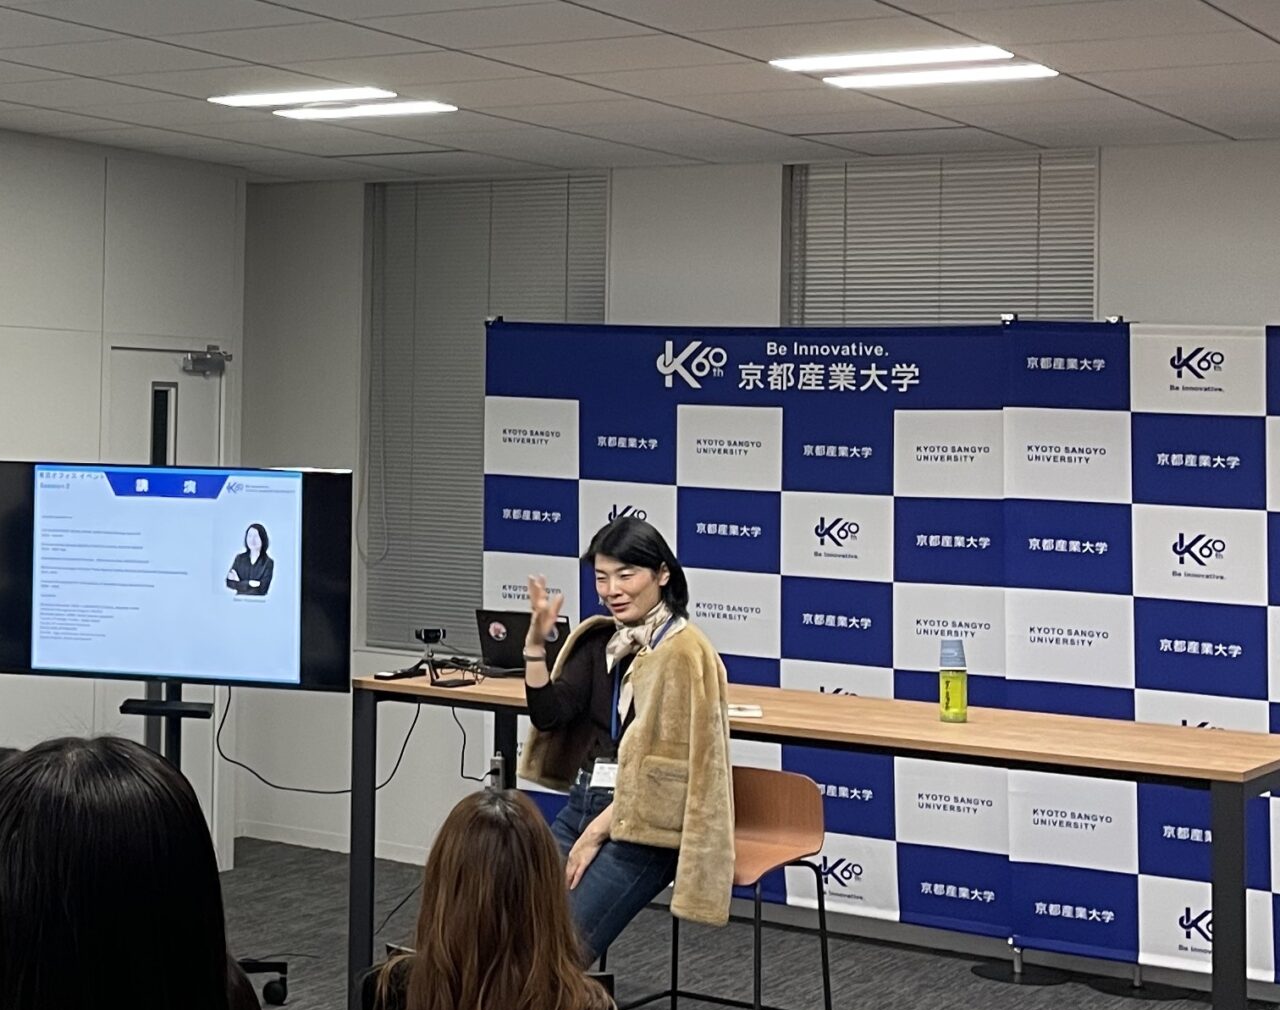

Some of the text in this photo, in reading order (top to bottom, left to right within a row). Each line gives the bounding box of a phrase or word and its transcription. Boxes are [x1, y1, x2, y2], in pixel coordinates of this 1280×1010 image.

[767, 342, 888, 356] Be Innovative.
[1027, 357, 1105, 370] 京都産業大学
[739, 362, 919, 392] 京都産業大学
[502, 428, 561, 438] KYOTO SANGYO
[502, 436, 550, 445] UNIVERSITY
[598, 436, 657, 449] 京都産業大学
[696, 439, 762, 448] KYOTO SANGYO
[696, 448, 749, 456] UNIVERSITY
[804, 445, 872, 458] 京都産業大学
[951, 446, 990, 454] SANGYO
[1027, 445, 1107, 456] KYOTO SANGYO
[1027, 455, 1091, 464] UNIVERSITY
[1157, 453, 1240, 468] 京都産業大学
[503, 509, 561, 522] 京都産業大学
[697, 523, 761, 537] 京都産業大学
[917, 535, 990, 548] 京都産業大学
[1029, 538, 1107, 554] 京都産業大学
[696, 602, 761, 614] KYOTO SANGYO
[696, 611, 748, 621] UNIVERSITY
[803, 613, 871, 629] 京都産業大学
[916, 619, 990, 630] KYOTO SANGYO
[916, 628, 976, 638] UNIVERSITY
[1029, 626, 1109, 639] KYOTO SANGYO
[1029, 636, 1093, 646] UNIVERSITY
[1160, 639, 1241, 657] 京都産業大学
[918, 793, 993, 807] KYOTO SANGYO
[918, 802, 978, 814] UNIVERSITY
[1033, 808, 1113, 824] KYOTO SANGYO
[1033, 818, 1096, 831] UNIVERSITY
[921, 883, 994, 902] 京都産業大学
[1035, 902, 1114, 922] 京都産業大学
